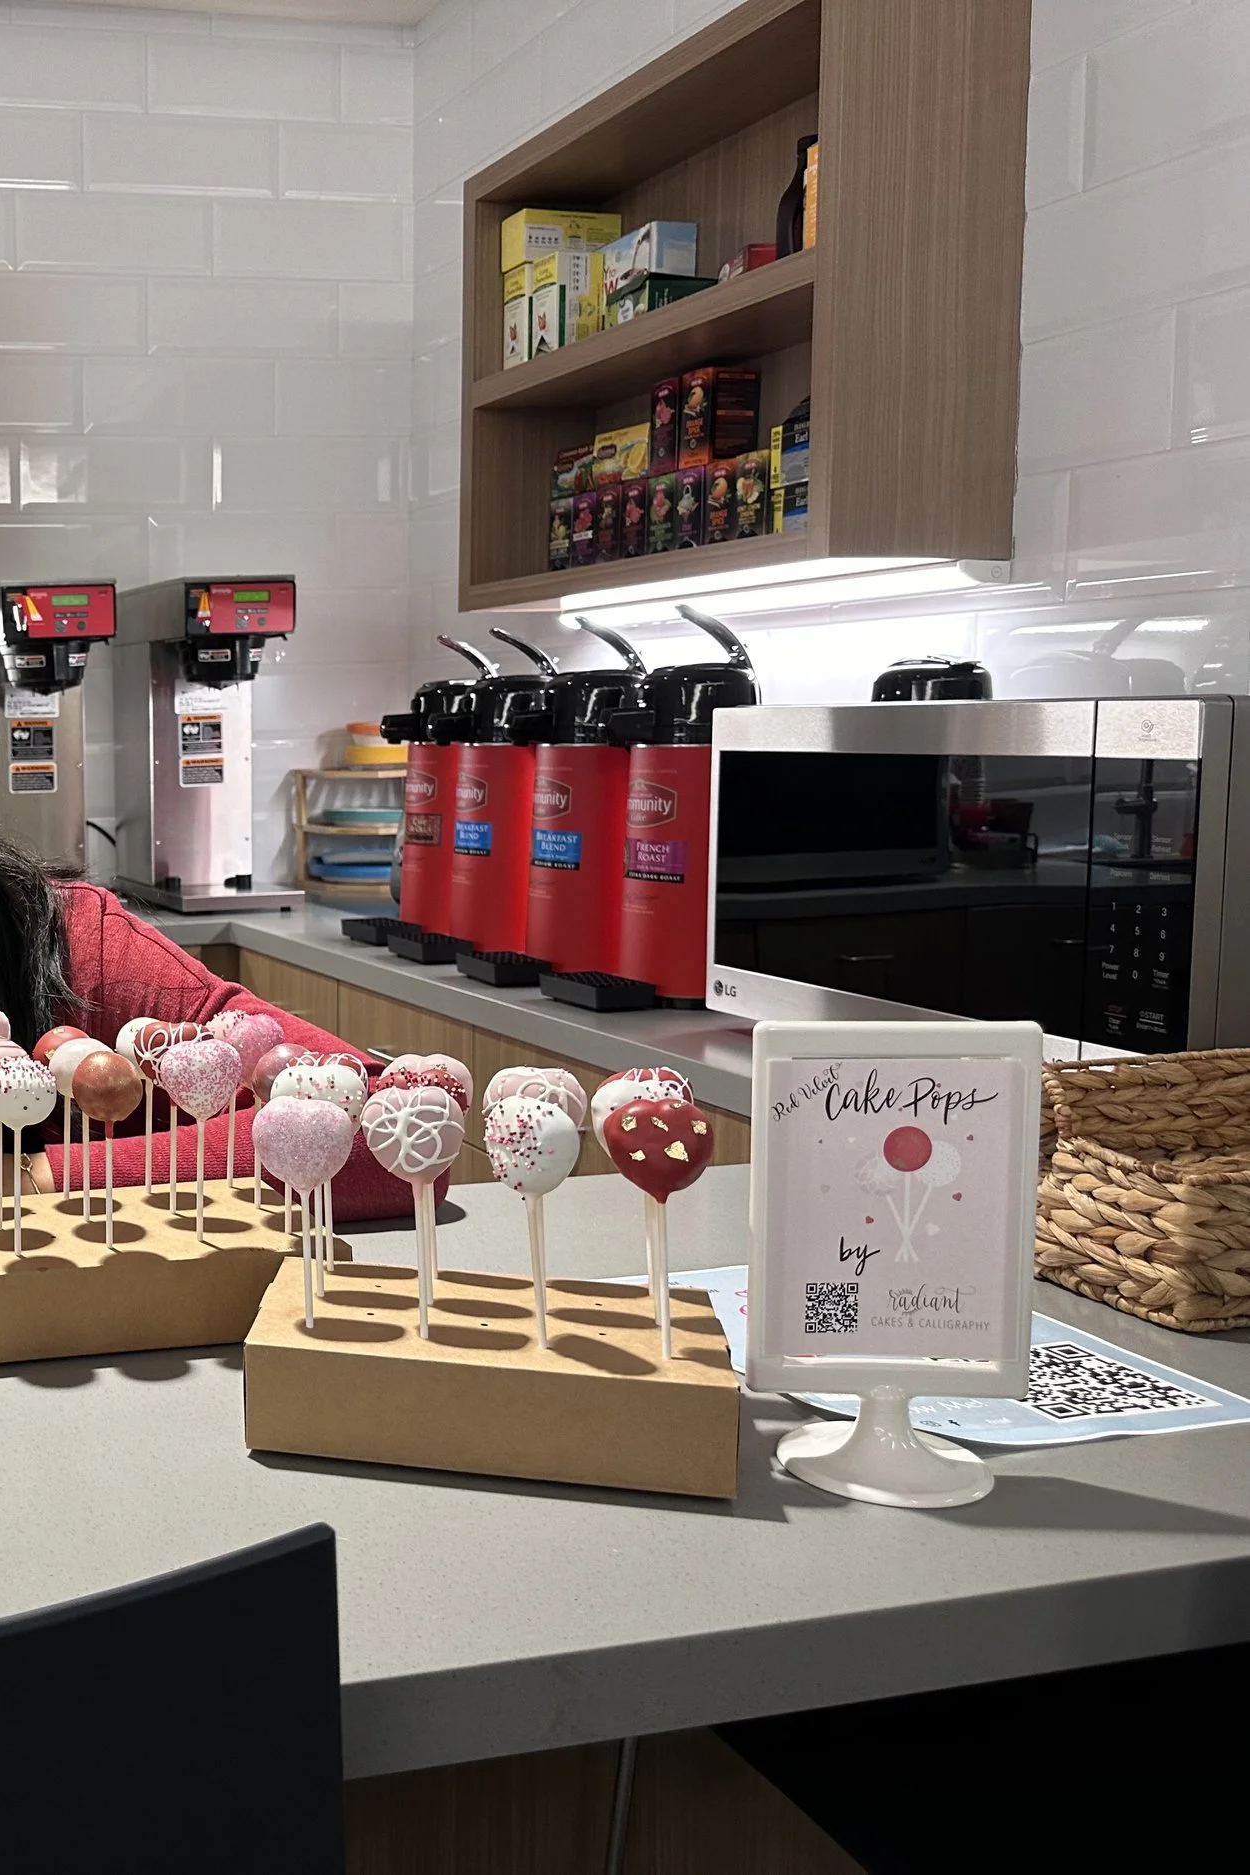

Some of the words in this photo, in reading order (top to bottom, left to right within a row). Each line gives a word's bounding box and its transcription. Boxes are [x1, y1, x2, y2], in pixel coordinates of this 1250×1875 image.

[536, 831, 578, 844] BREAKFAST
[541, 841, 567, 851] BLEND
[636, 841, 670, 853] FRENCH
[637, 851, 666, 863] ROAST
[1112, 902, 1116, 911] 1
[1136, 904, 1142, 914] 2
[1161, 907, 1167, 917] 3
[1110, 923, 1116, 933] 4
[1134, 926, 1141, 936] 5
[1160, 929, 1166, 940] 6
[1109, 944, 1115, 954] 7
[1133, 947, 1139, 957] 8
[1159, 951, 1165, 961] 9
[1132, 969, 1138, 980] 0
[724, 984, 737, 998] LG
[1144, 1010, 1165, 1021] START
[770, 1092, 800, 1122] Red
[800, 1062, 843, 1100] Velvet
[825, 1068, 902, 1121] Cake
[902, 1077, 999, 1125] Pops
[839, 1236, 881, 1277] by
[887, 1283, 976, 1316] radiant
[870, 1316, 903, 1328] CAKES
[907, 1317, 914, 1328] &
[918, 1318, 990, 1331] CALLIGRAPHY
